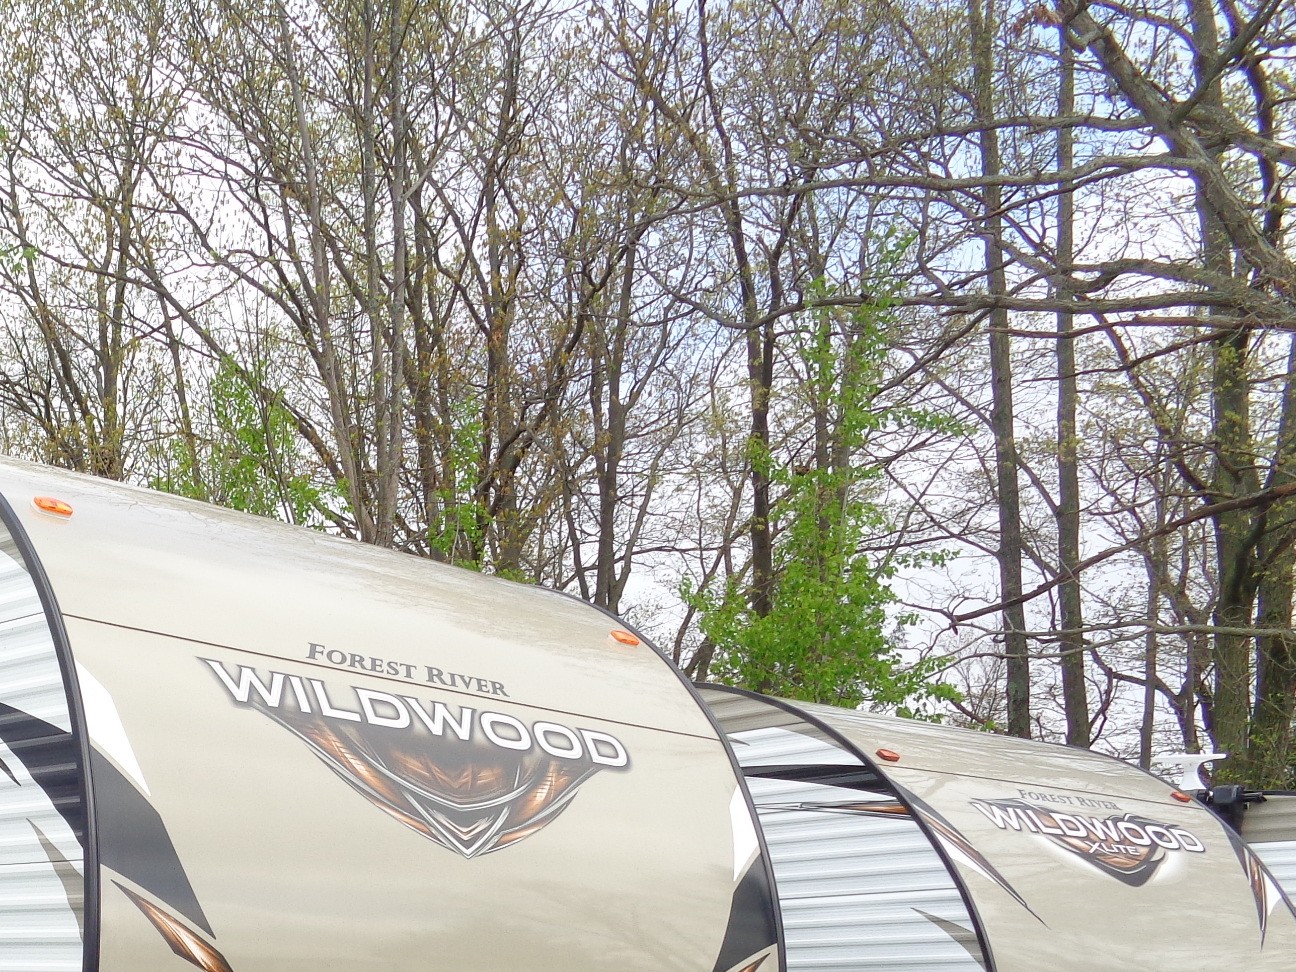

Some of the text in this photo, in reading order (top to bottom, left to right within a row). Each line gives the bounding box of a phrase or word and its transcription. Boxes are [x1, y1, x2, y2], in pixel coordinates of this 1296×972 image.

[306, 642, 511, 698] FOREST RIVER
[203, 658, 630, 769] WILDWOOD
[1017, 789, 1123, 811] FOREST RIVER
[971, 801, 1206, 853] WILDWOOD
[1084, 840, 1142, 856] XLITE
